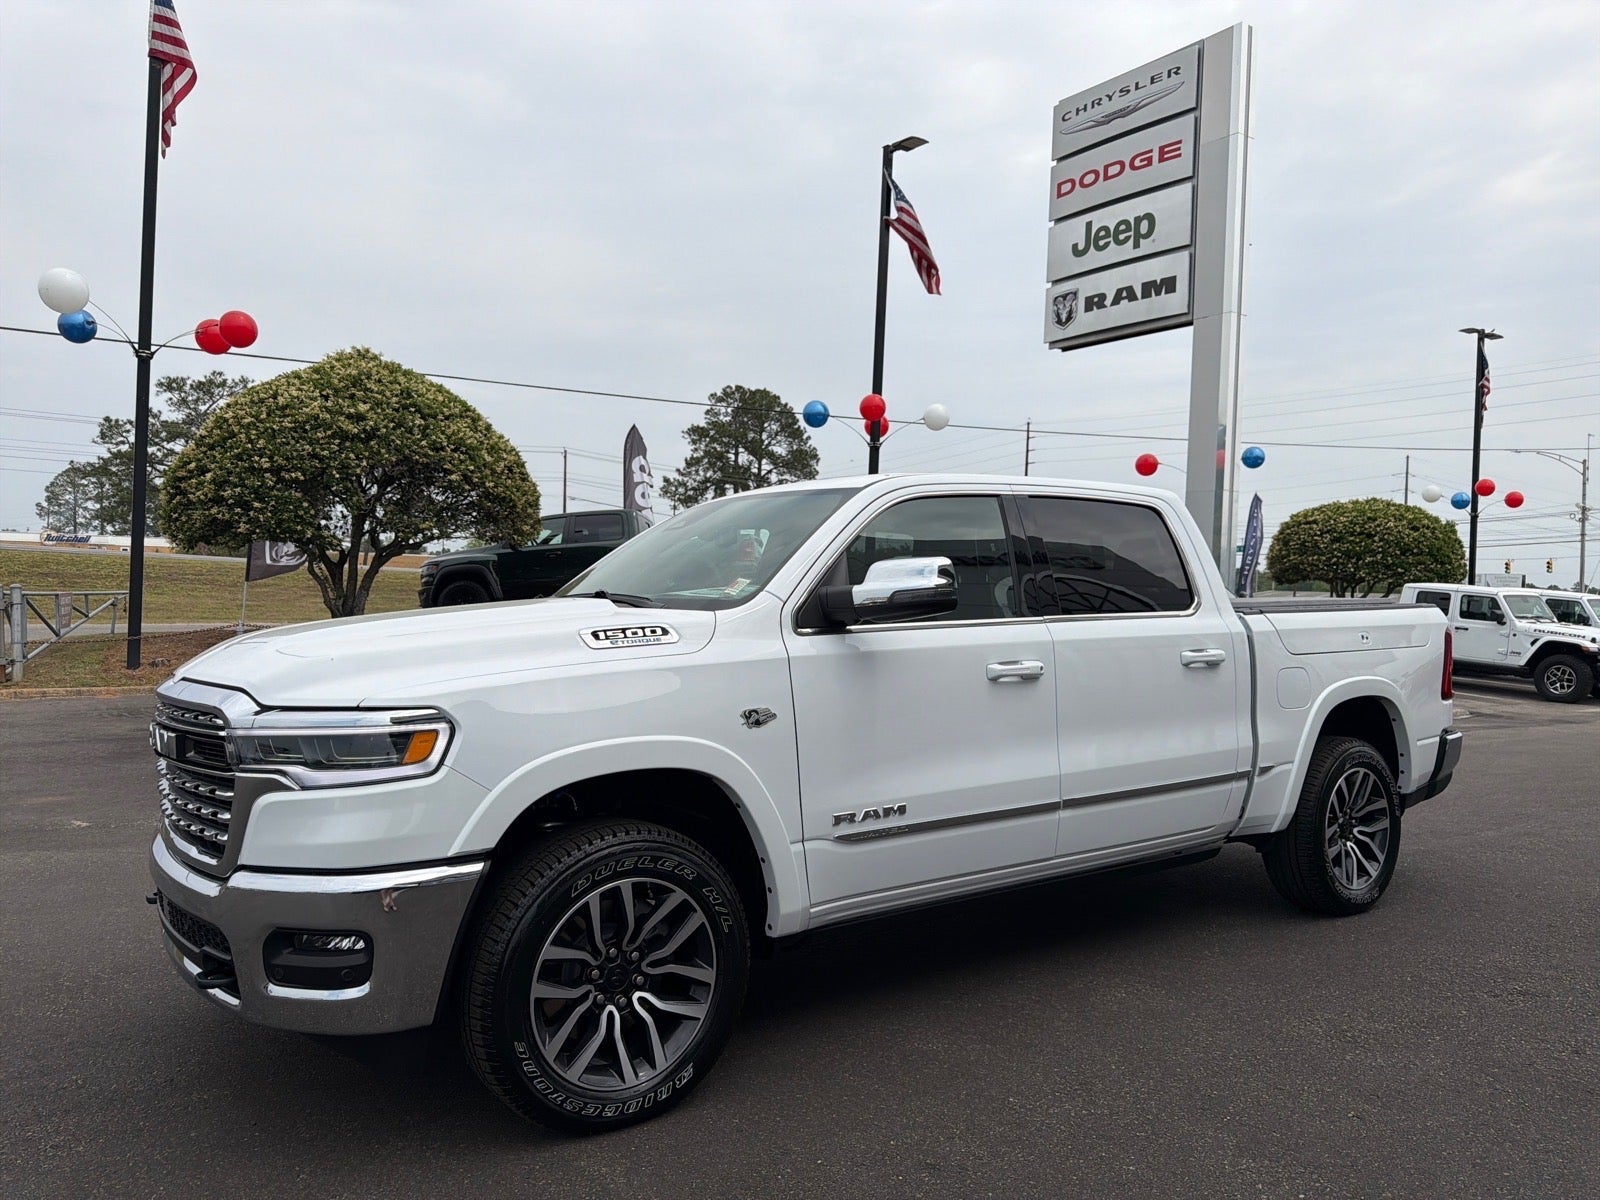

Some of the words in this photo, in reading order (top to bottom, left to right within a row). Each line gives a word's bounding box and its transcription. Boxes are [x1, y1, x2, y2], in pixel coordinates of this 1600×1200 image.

[1061, 65, 1182, 123] CHRYSLER
[1056, 139, 1183, 200] DODGE
[1071, 212, 1156, 258] Jeep
[1083, 275, 1177, 314] RAM
[594, 627, 663, 641] 1500
[1533, 628, 1586, 639] RUBICON
[832, 802, 907, 826] RAM
[571, 856, 697, 898] DUELER
[513, 1041, 694, 1117] BRIDGESTONE
